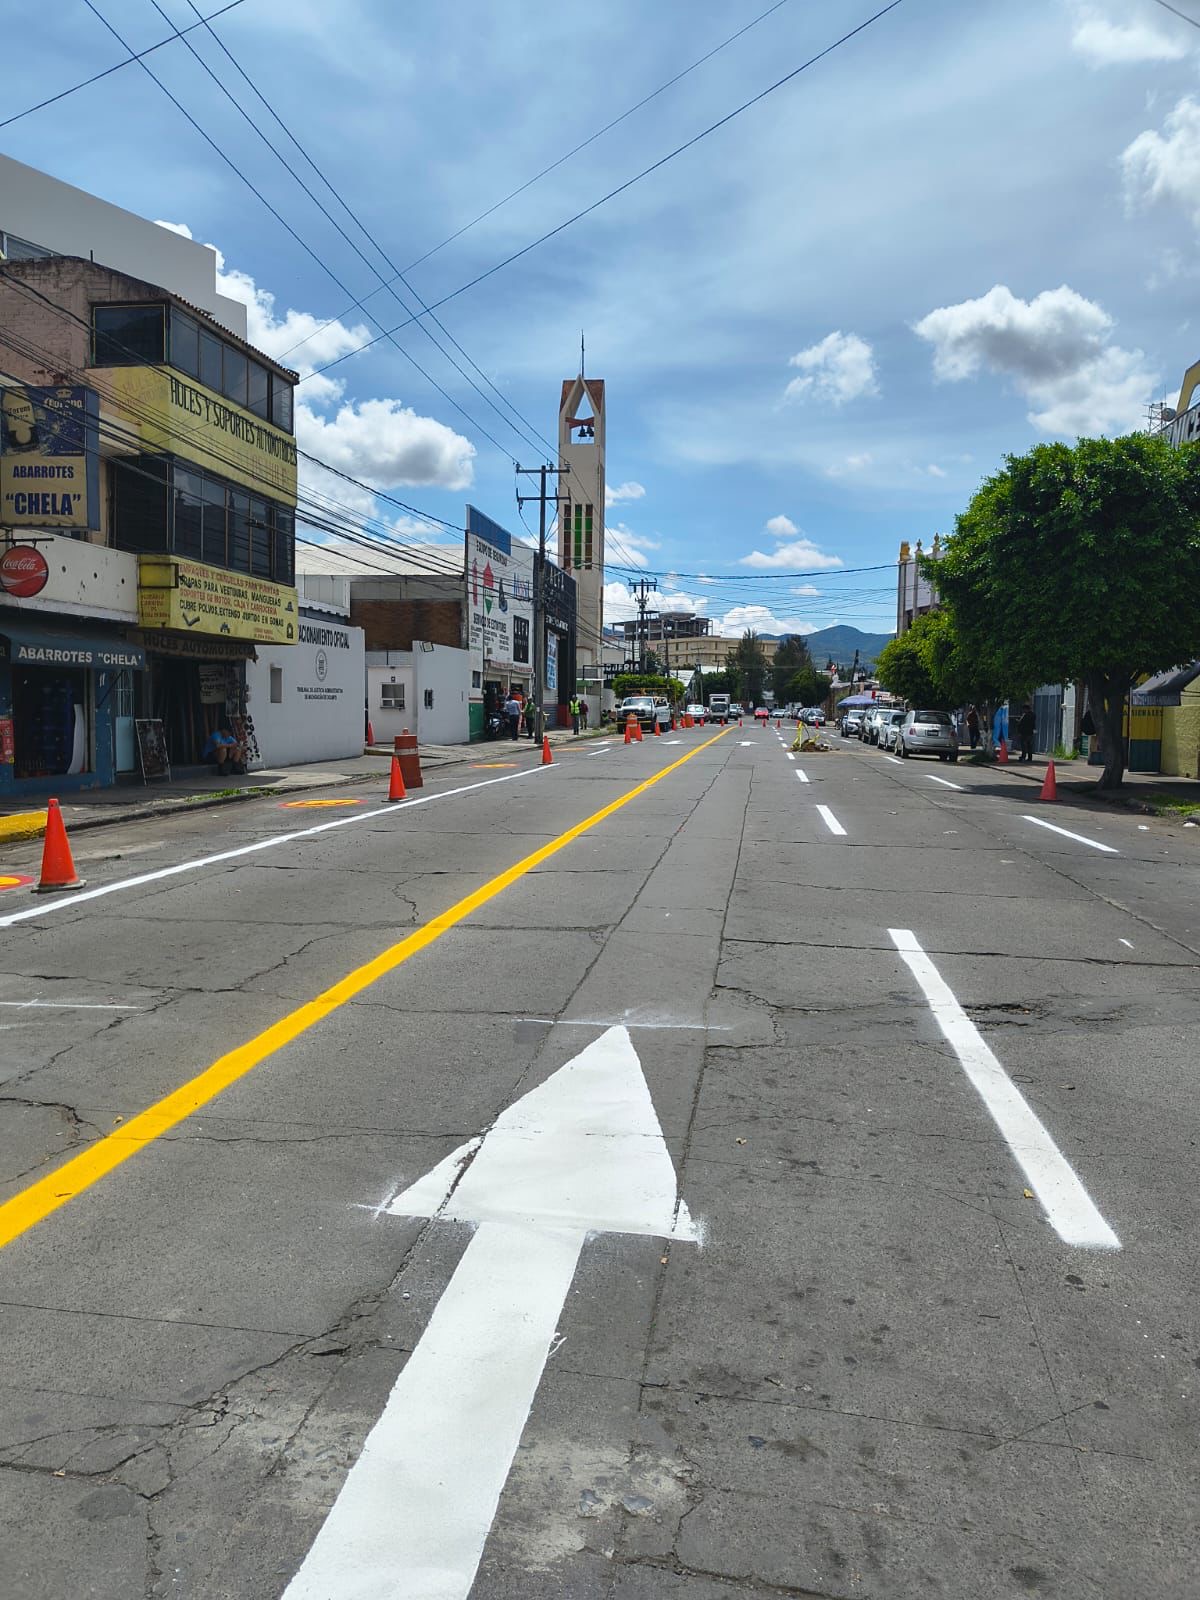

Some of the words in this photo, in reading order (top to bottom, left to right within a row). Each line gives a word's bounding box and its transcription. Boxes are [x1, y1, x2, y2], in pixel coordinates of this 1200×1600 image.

[170, 376, 201, 416] HULES
[13, 465, 74, 478] ABARROTES
[6, 492, 81, 515] "CHELA"
[204, 580, 218, 593] PARA
[251, 590, 281, 607] MANGUERAS
[180, 599, 197, 612] CUBRE
[18, 646, 93, 663] ABARROTES
